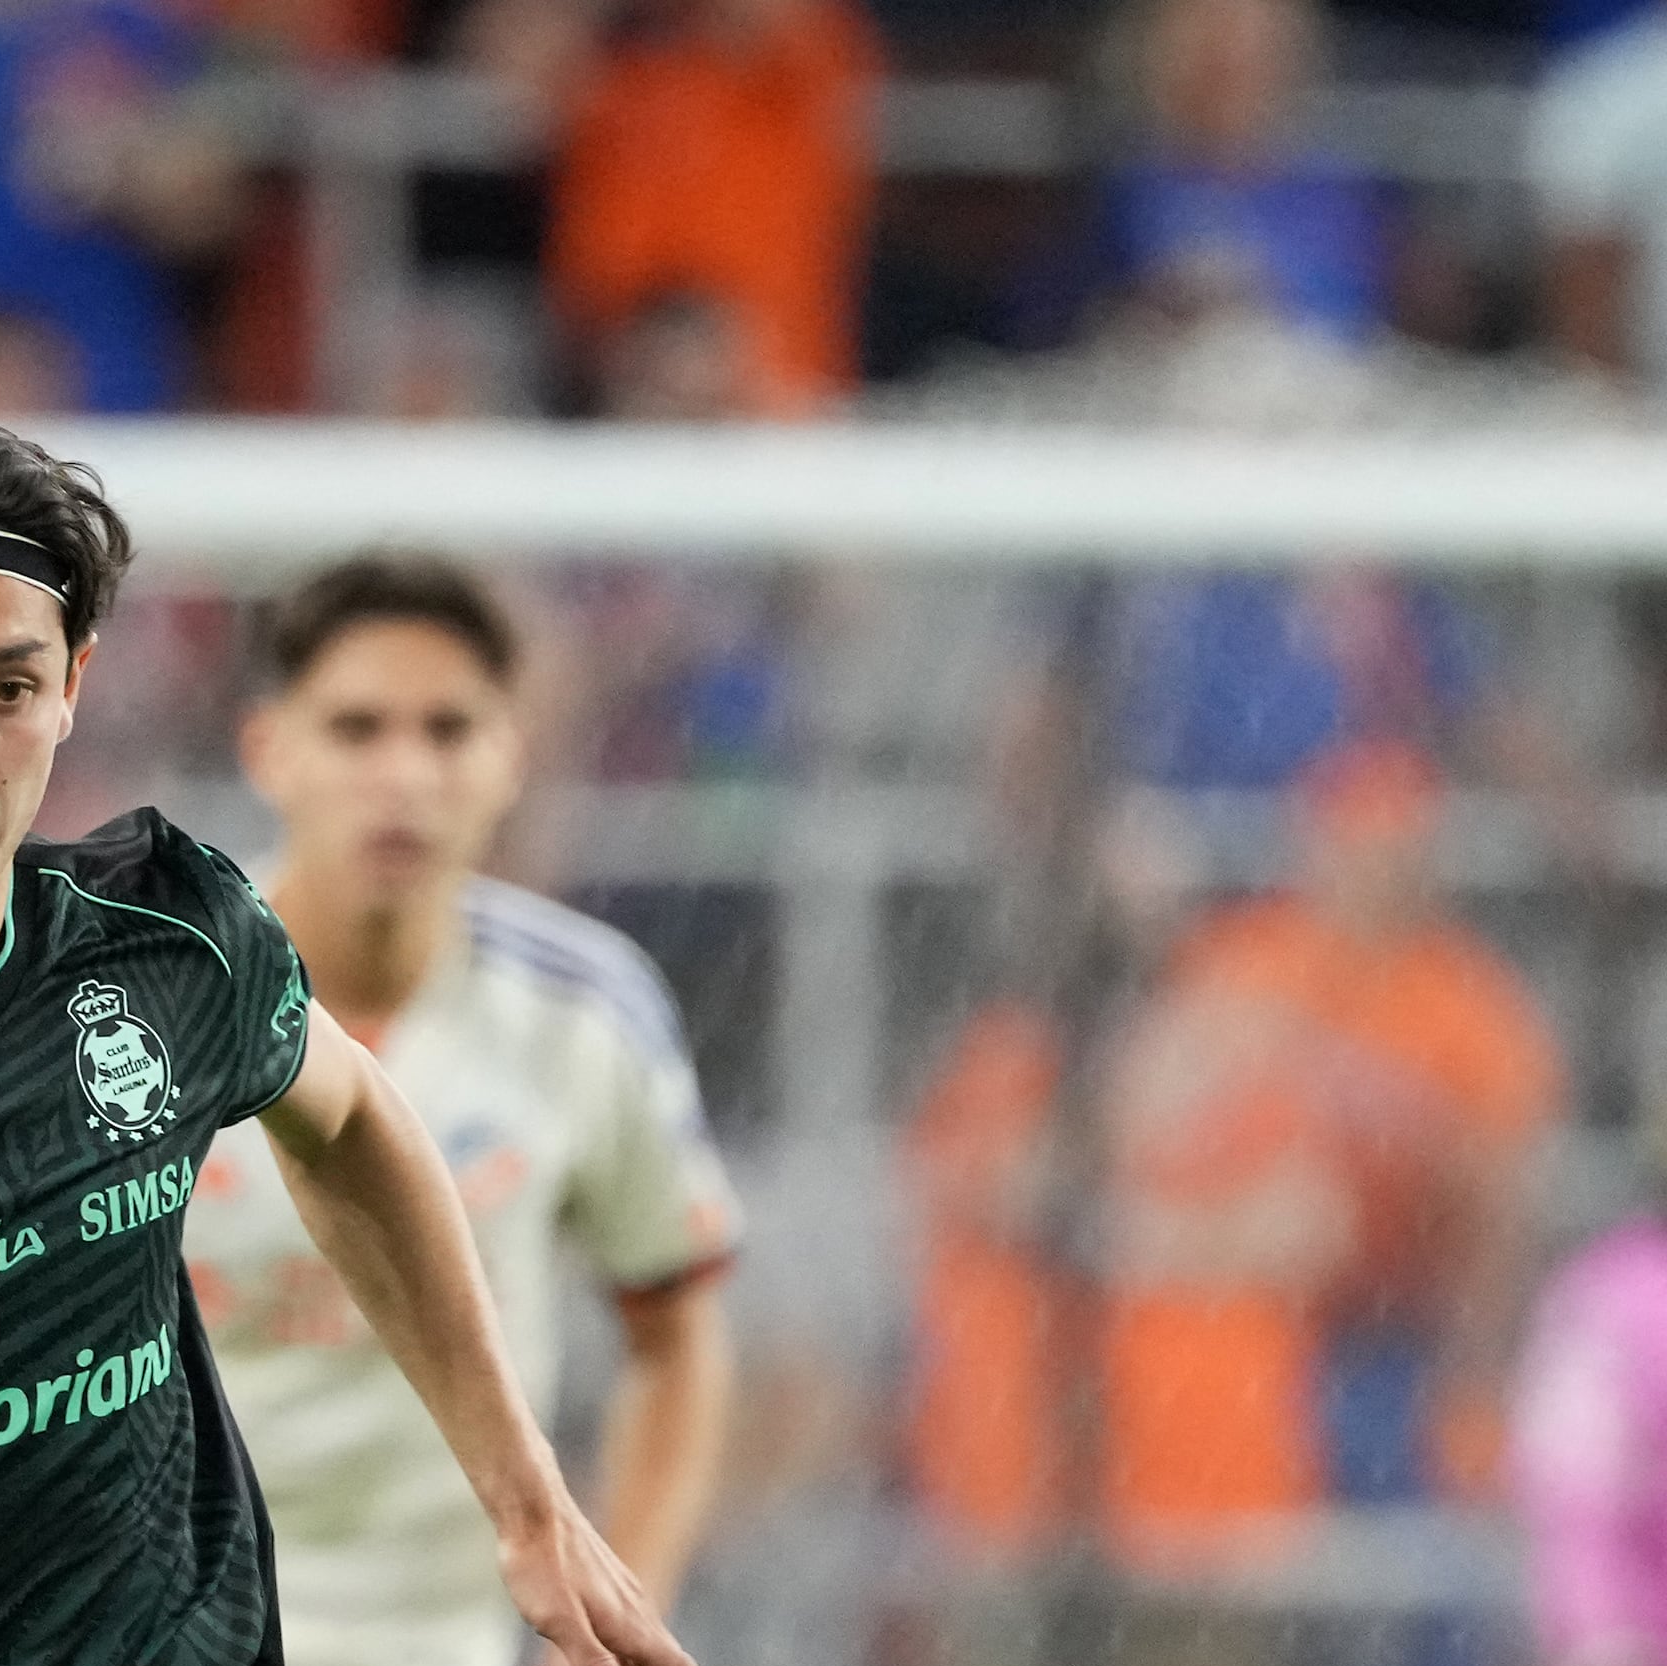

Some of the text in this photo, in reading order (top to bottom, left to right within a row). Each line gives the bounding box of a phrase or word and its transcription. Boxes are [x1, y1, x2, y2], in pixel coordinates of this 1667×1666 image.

[106, 1044, 130, 1057] CLUB
[112, 1078, 148, 1096] LAGUNA
[79, 1156, 195, 1242] SIMSA
